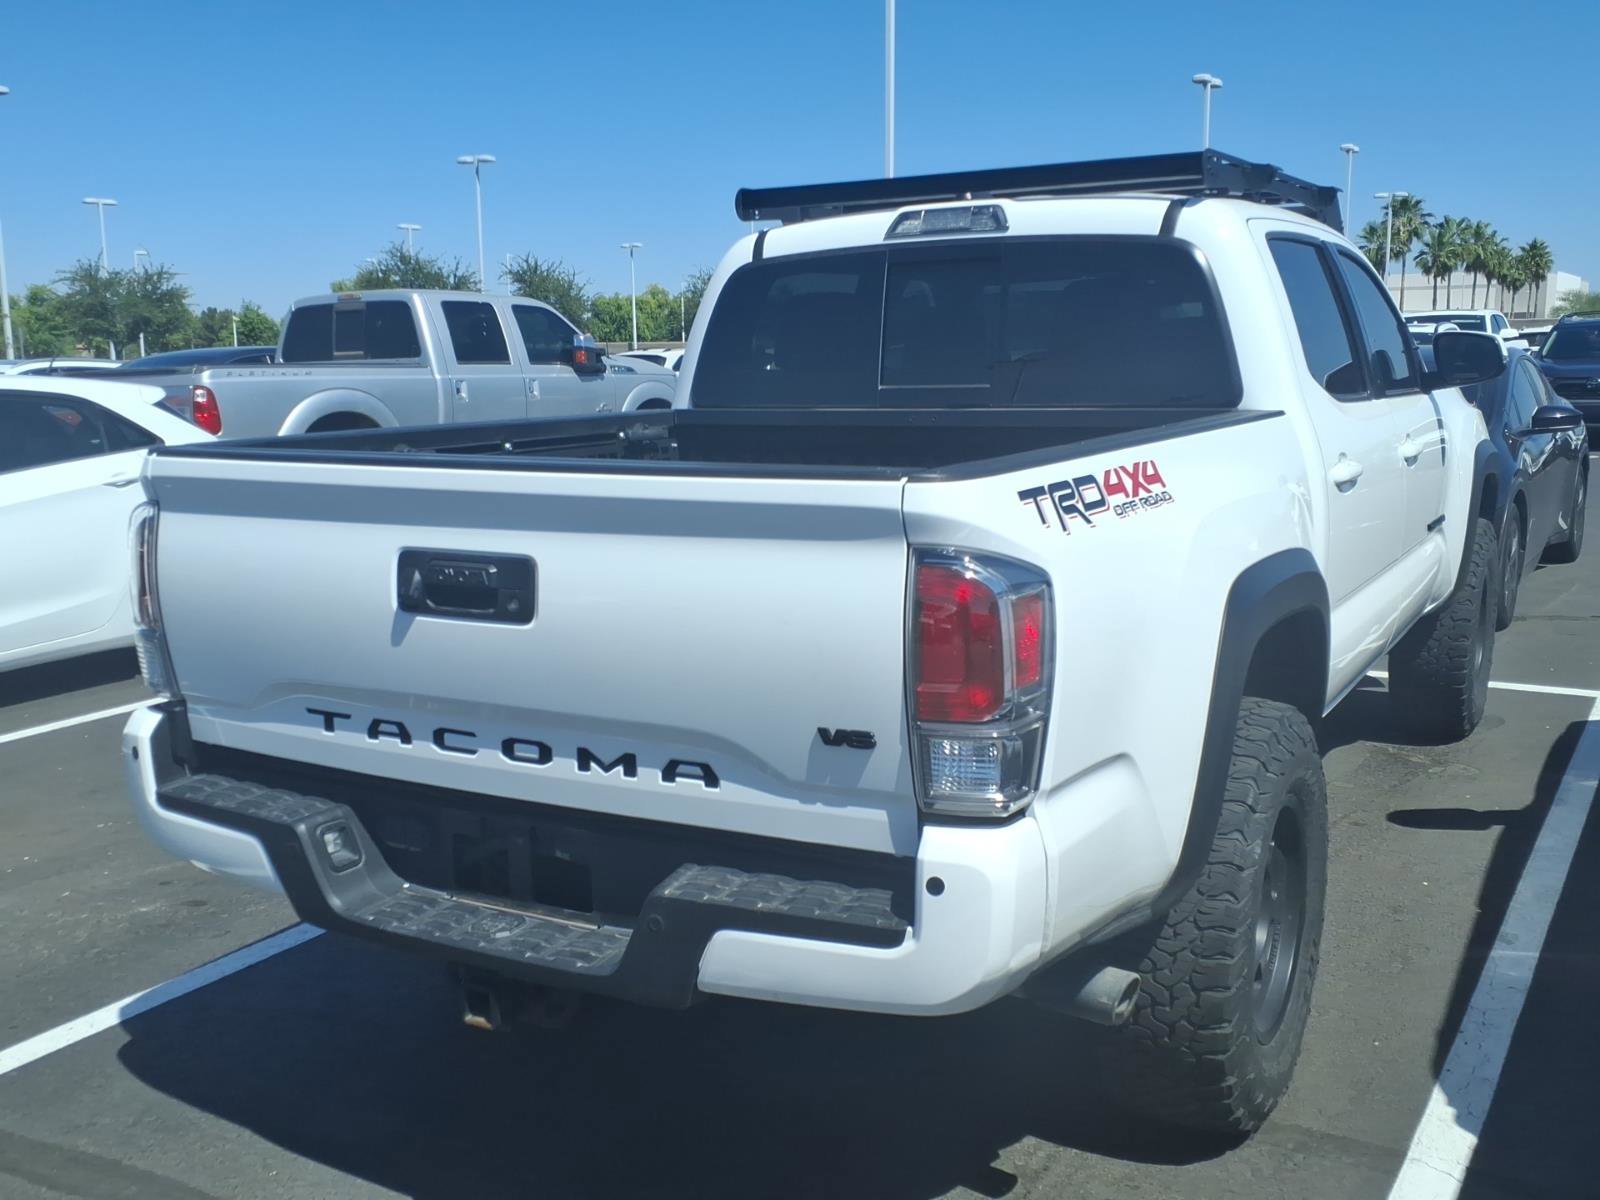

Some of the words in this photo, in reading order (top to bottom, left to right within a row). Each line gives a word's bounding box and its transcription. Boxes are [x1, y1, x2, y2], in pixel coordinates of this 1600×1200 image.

[1017, 474, 1109, 534] TRD
[1103, 460, 1166, 498] 4X4
[1113, 500, 1140, 518] OFF
[1139, 491, 1174, 510] ROAD
[305, 707, 719, 789] TACOMA
[817, 727, 877, 750] V6
